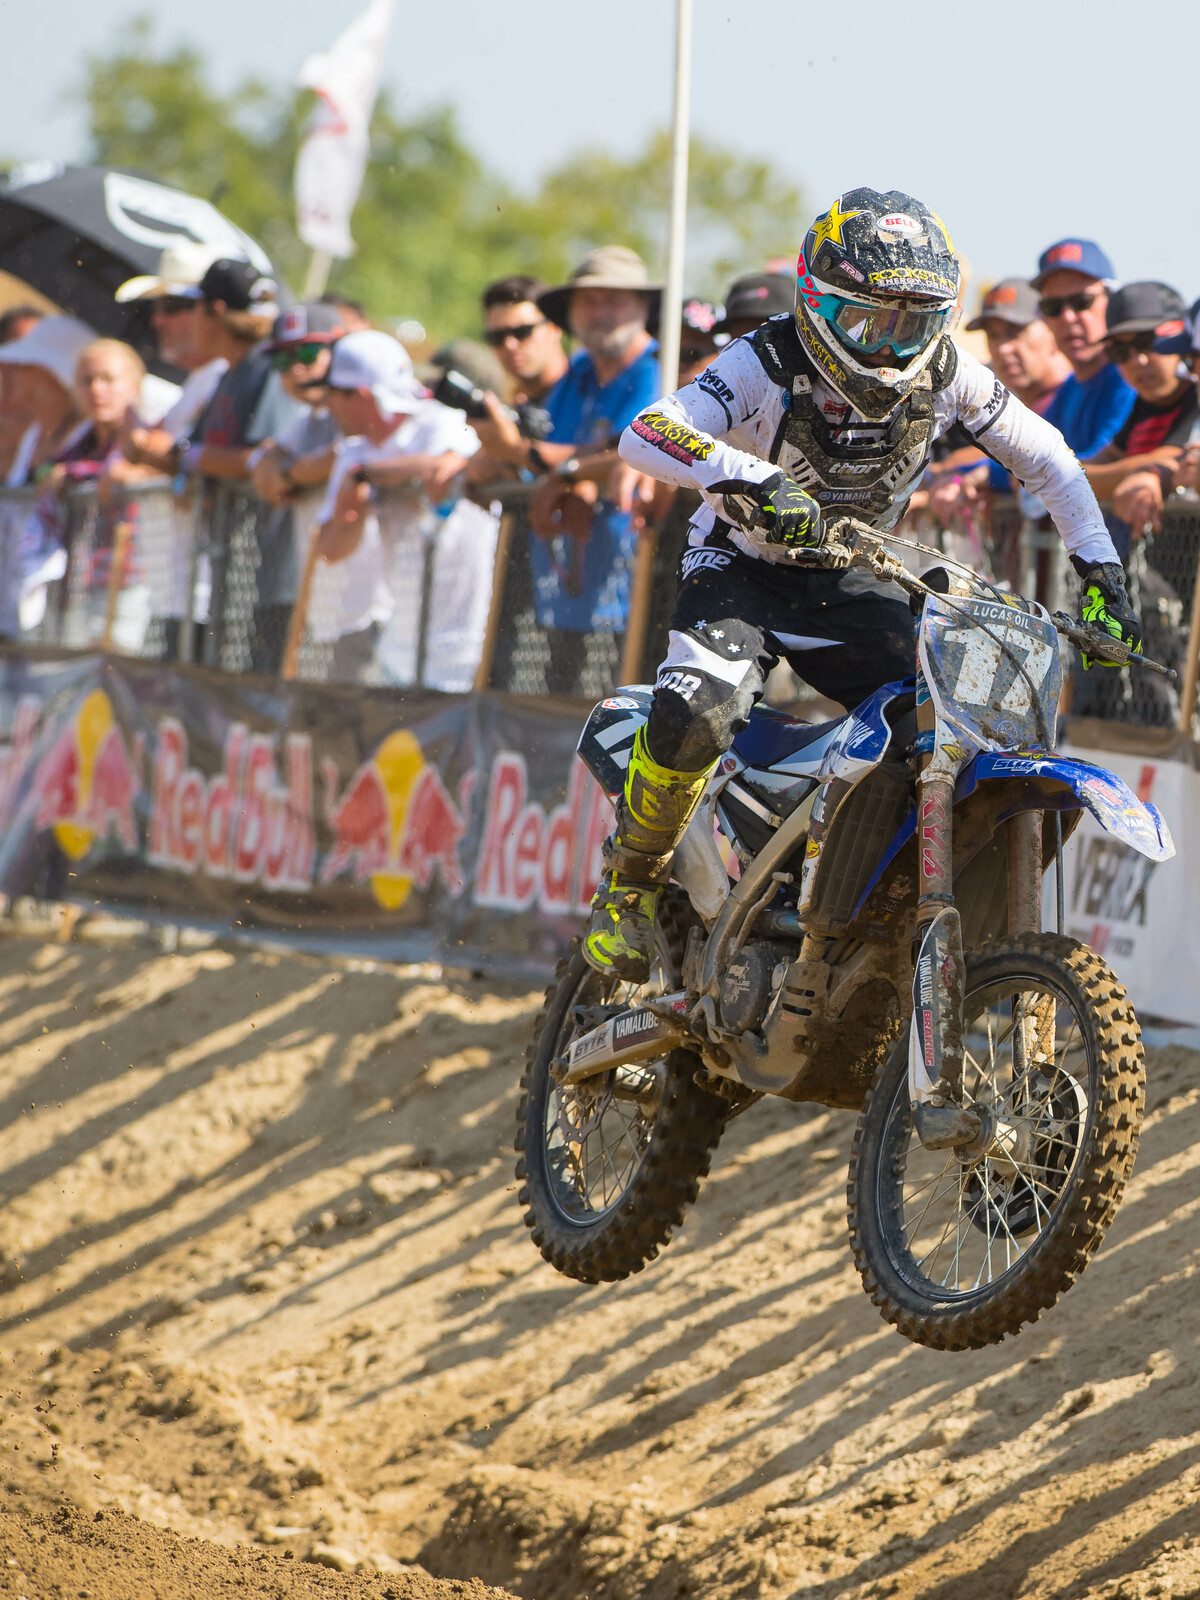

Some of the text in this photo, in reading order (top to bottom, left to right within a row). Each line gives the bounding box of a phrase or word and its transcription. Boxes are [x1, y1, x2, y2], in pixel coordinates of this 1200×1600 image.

[885, 217, 916, 229] BELL
[765, 342, 782, 369] thor
[937, 344, 950, 373] thor
[662, 441, 698, 466] DRINK
[829, 462, 881, 474] thor
[832, 491, 872, 501] YAMAHA
[780, 507, 809, 516] THOR
[973, 605, 1013, 624] LUCAS
[1015, 613, 1029, 630] OIL
[944, 622, 1053, 717] 17
[922, 788, 947, 880] KYB
[919, 954, 933, 1007] YAMALUBE
[923, 1009, 935, 1067] BRAKING
